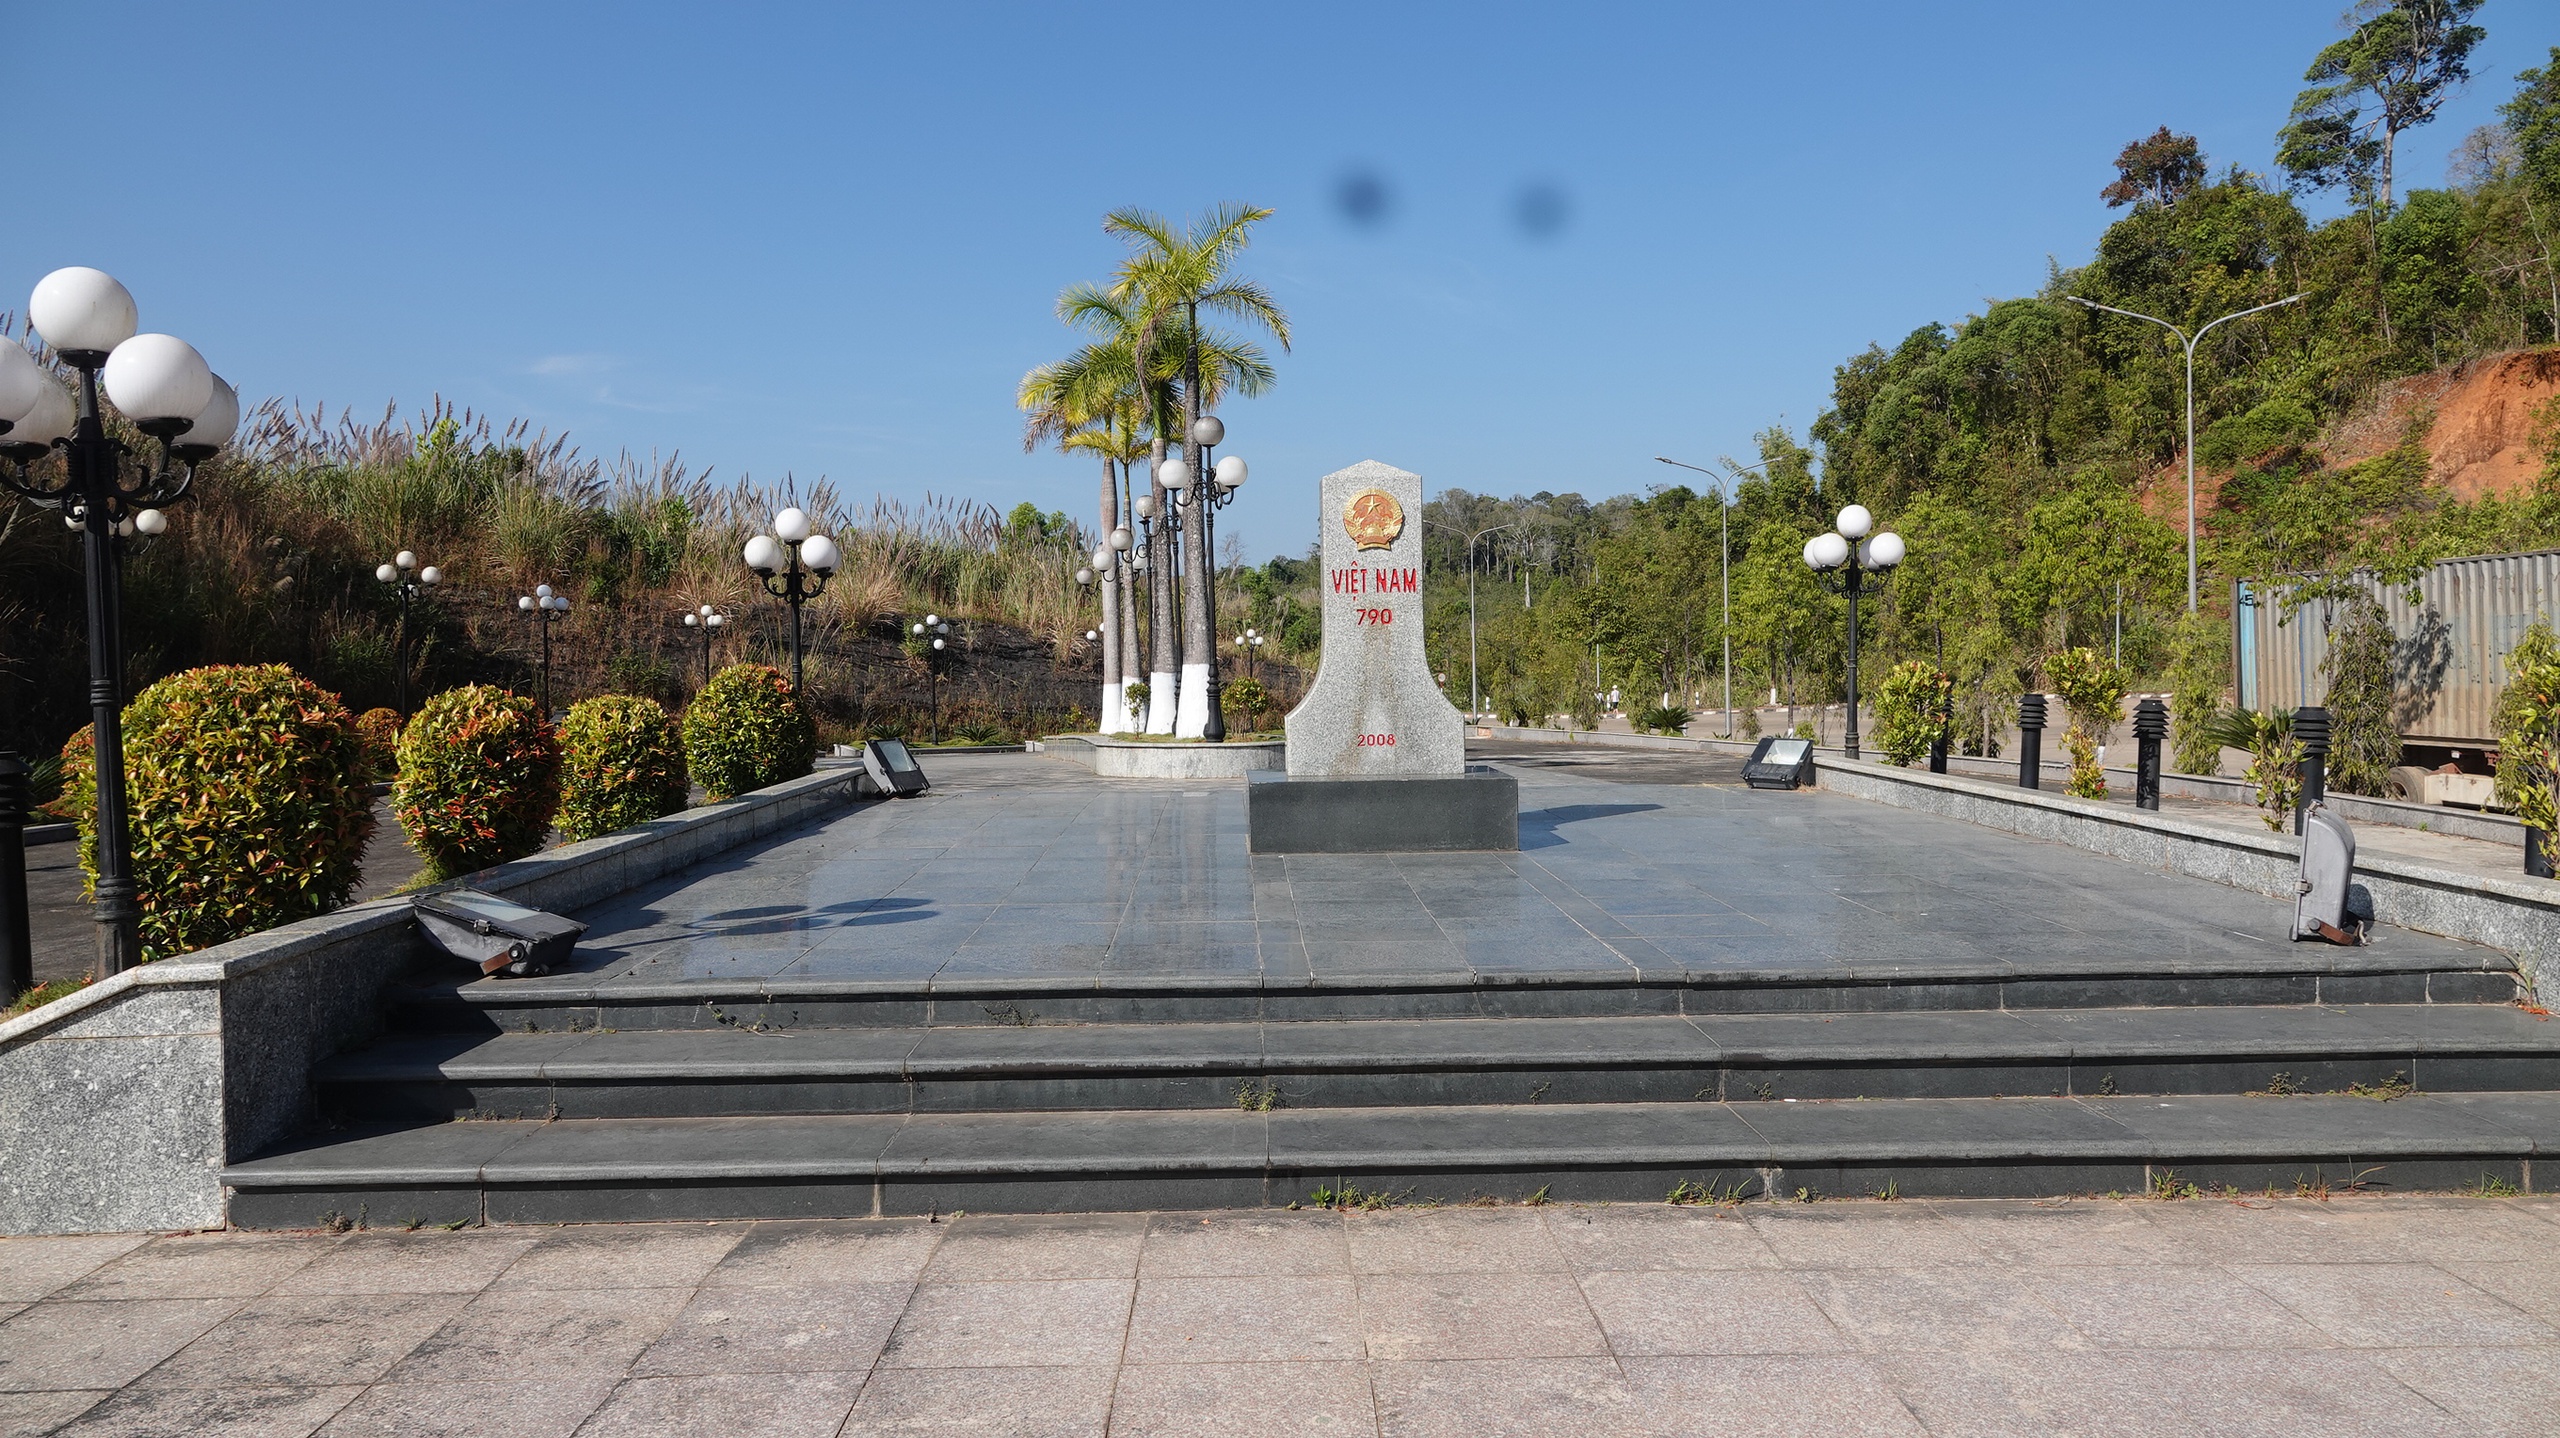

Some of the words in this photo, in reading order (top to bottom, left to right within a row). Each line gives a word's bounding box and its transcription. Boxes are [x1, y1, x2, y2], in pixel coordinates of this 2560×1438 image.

[1331, 560, 1367, 601] VIỆT
[1376, 568, 1417, 593] NAM
[1356, 608, 1393, 626] 790
[1357, 733, 1396, 747] 2008
